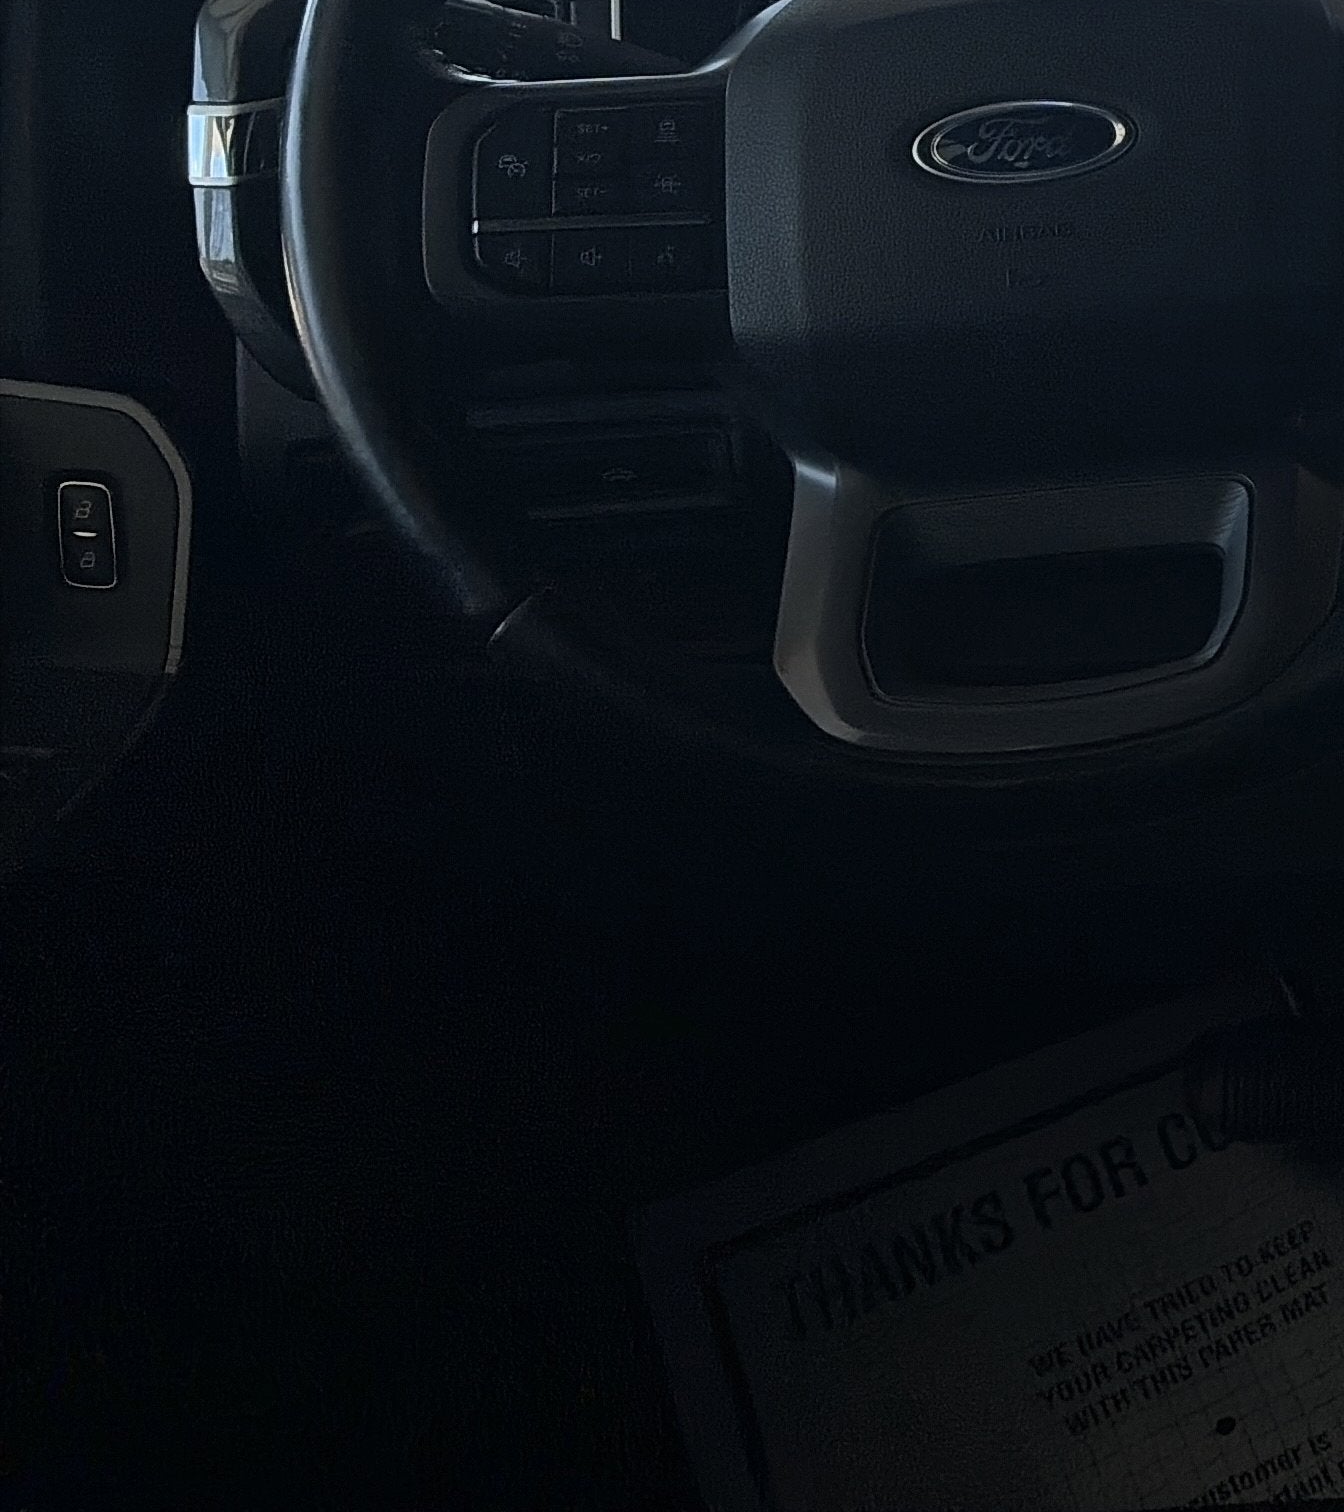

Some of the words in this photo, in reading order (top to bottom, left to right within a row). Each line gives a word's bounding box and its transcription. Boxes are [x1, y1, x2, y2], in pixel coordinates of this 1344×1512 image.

[967, 115, 1076, 164] Ford
[779, 1189, 1015, 1338] THANKS
[1023, 1134, 1148, 1230] FOR
[1077, 1310, 1142, 1358] HAVE
[1144, 1275, 1217, 1320] TRIED
[1222, 1254, 1254, 1283] TO
[1259, 1219, 1315, 1264] KEEP
[1041, 1359, 1110, 1408] YOUR
[1117, 1292, 1250, 1373] CARPETING
[1256, 1249, 1331, 1304] CLEAN
[1066, 1388, 1130, 1434] WITH
[1134, 1355, 1193, 1400] THIS
[1199, 1315, 1276, 1368] PAPER
[1281, 1282, 1330, 1324] MAT
